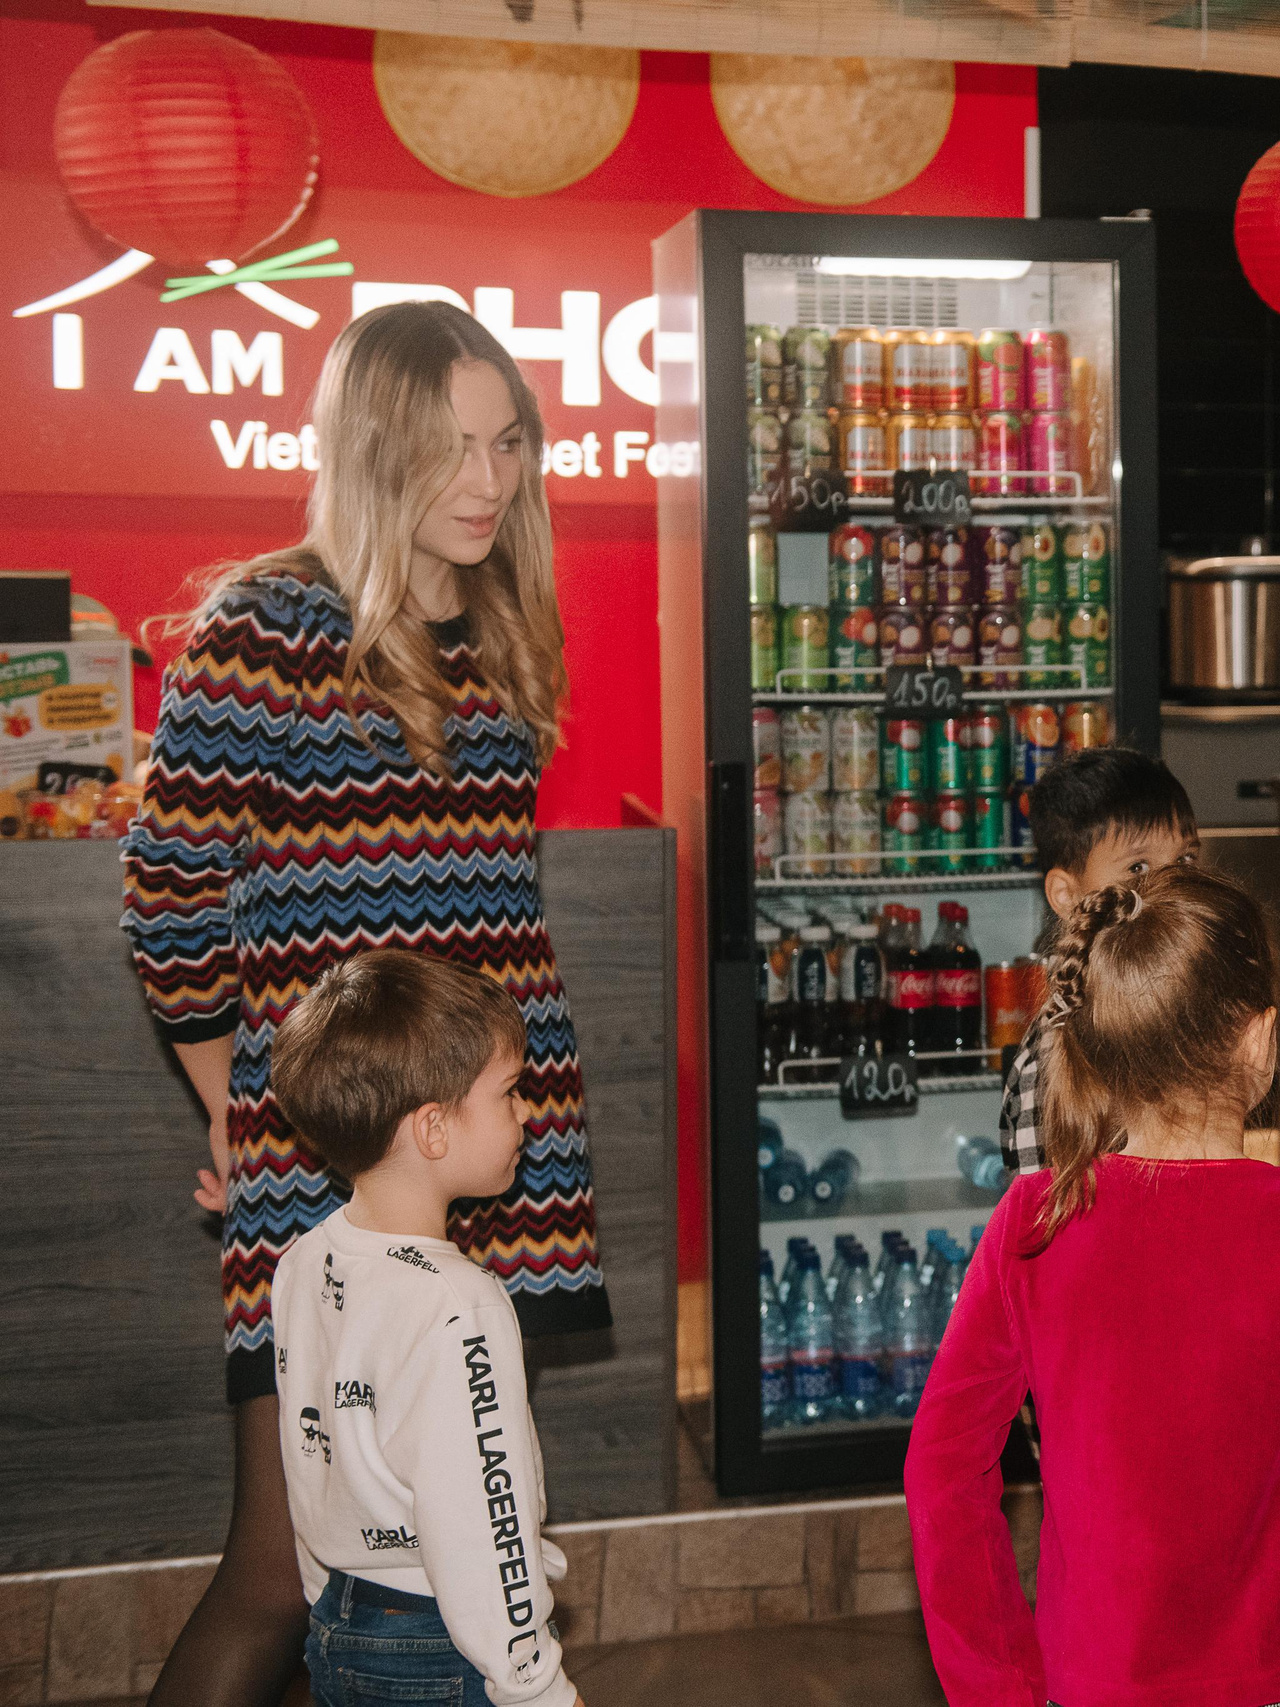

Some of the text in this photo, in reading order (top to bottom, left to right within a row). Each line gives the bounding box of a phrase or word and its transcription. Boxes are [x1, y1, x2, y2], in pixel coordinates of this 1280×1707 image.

[53, 313, 84, 390] I
[133, 328, 284, 397] AM
[462, 1334, 534, 1627] KARL LAGERFELD
[360, 1524, 418, 1543] KARL
